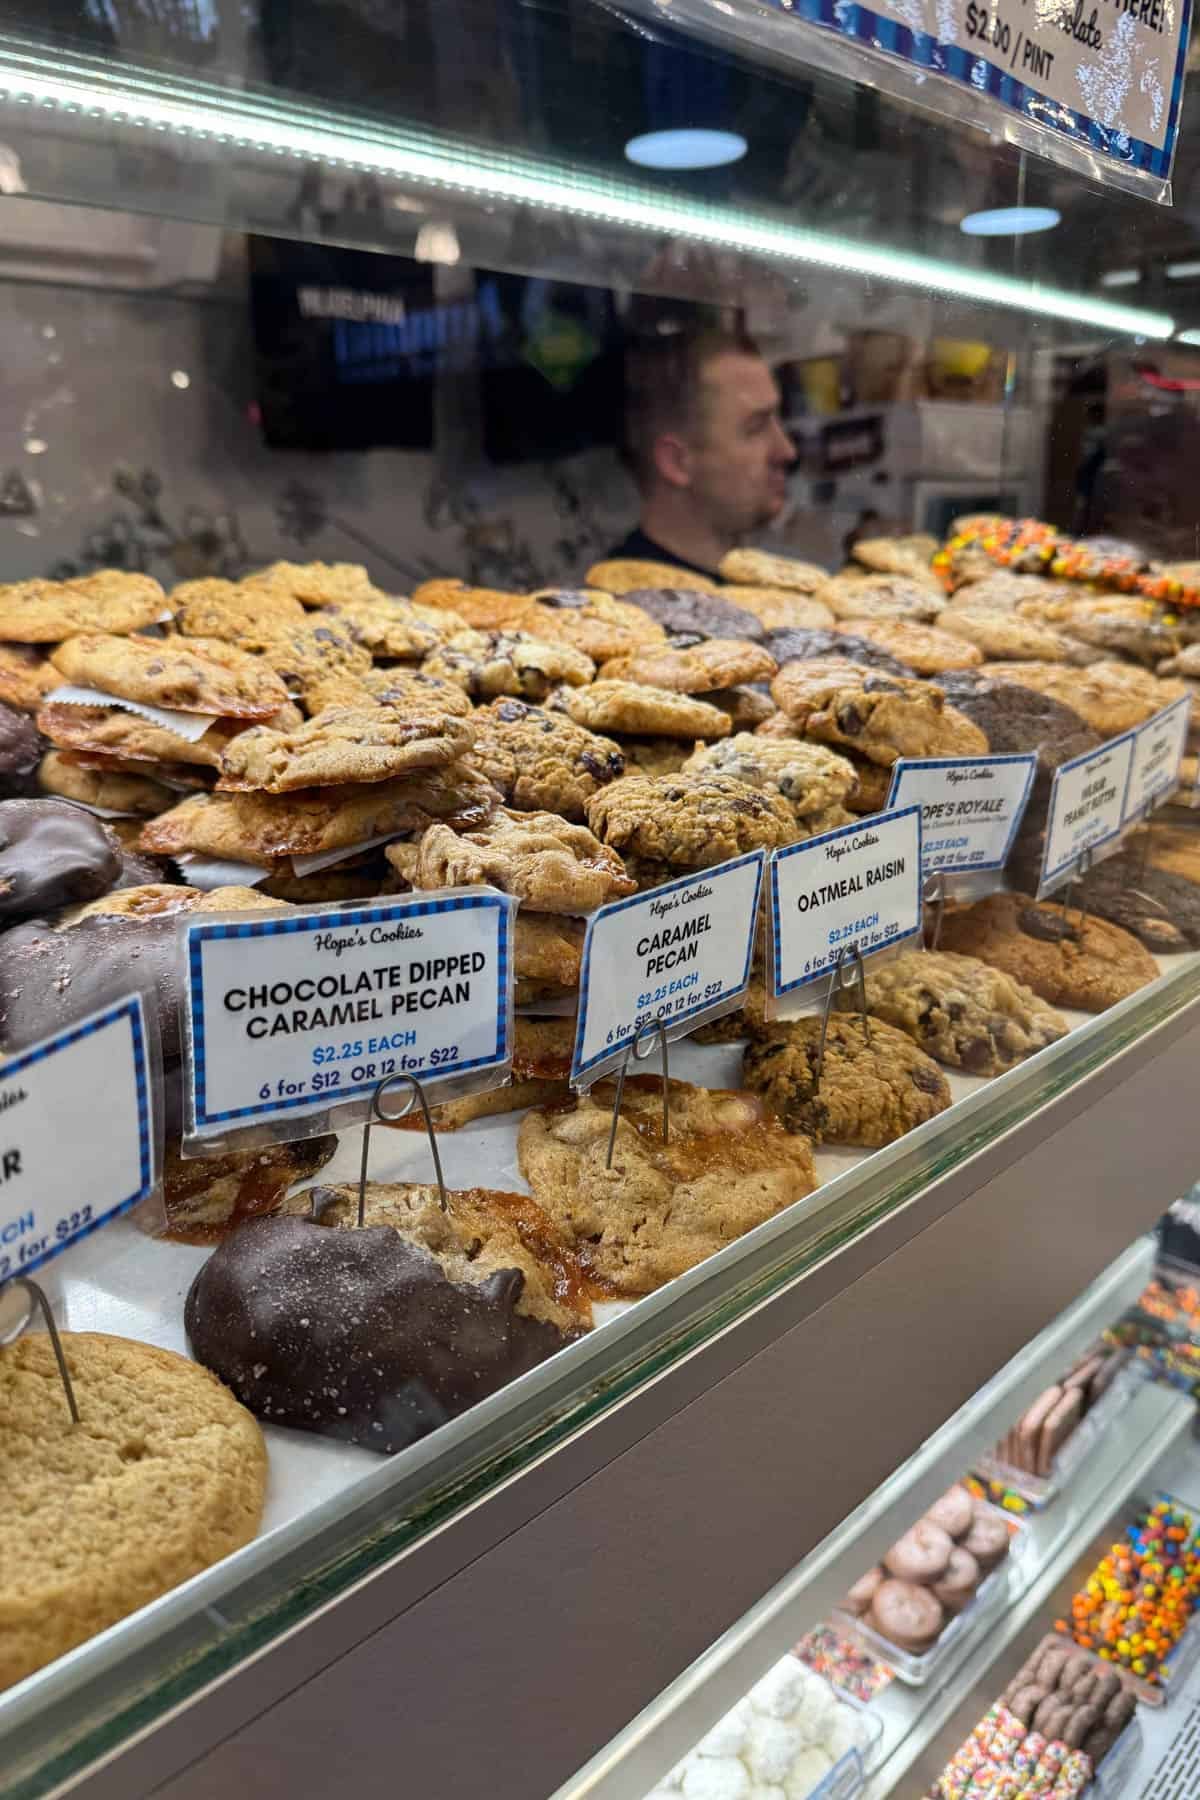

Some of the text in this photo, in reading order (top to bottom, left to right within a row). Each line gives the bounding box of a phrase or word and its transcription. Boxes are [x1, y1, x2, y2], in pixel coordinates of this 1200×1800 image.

[965, 0, 1054, 80] $2.00 / PINT
[1052, 0, 1103, 50] olate
[923, 797, 1006, 820] OPE'S ROYALE
[825, 831, 880, 862] Hope's Cookies
[944, 836, 969, 850] EACH
[649, 883, 713, 920] Hope's Cookies
[798, 857, 905, 912] OATMEAL RAISIN
[314, 923, 424, 957] Hope's Cookies
[636, 913, 712, 957] CARAMEL
[828, 911, 879, 944] $2.25 EACH
[646, 940, 699, 977] PECAN
[804, 961, 811, 973] 6
[812, 956, 827, 969] for
[861, 934, 869, 948] 12
[871, 931, 883, 943] for
[884, 921, 899, 937] $22
[223, 951, 485, 1012] CHOCOLATE DIPPED
[636, 971, 699, 1009] $2.25 EACH
[246, 981, 471, 1039] CARAMEL PECAN
[606, 1029, 614, 1043] 6
[616, 1024, 632, 1039] for
[656, 1002, 673, 1018] OR
[675, 998, 685, 1009] 12
[687, 992, 702, 1006] for
[704, 981, 723, 998] $22
[312, 1030, 417, 1066] $2.25 EACH
[259, 1046, 459, 1100] 6 for $12 OR 12 for $22
[0, 1149, 22, 1183] R
[0, 1209, 34, 1244] CH
[0, 1204, 93, 1276] 2 for $22
